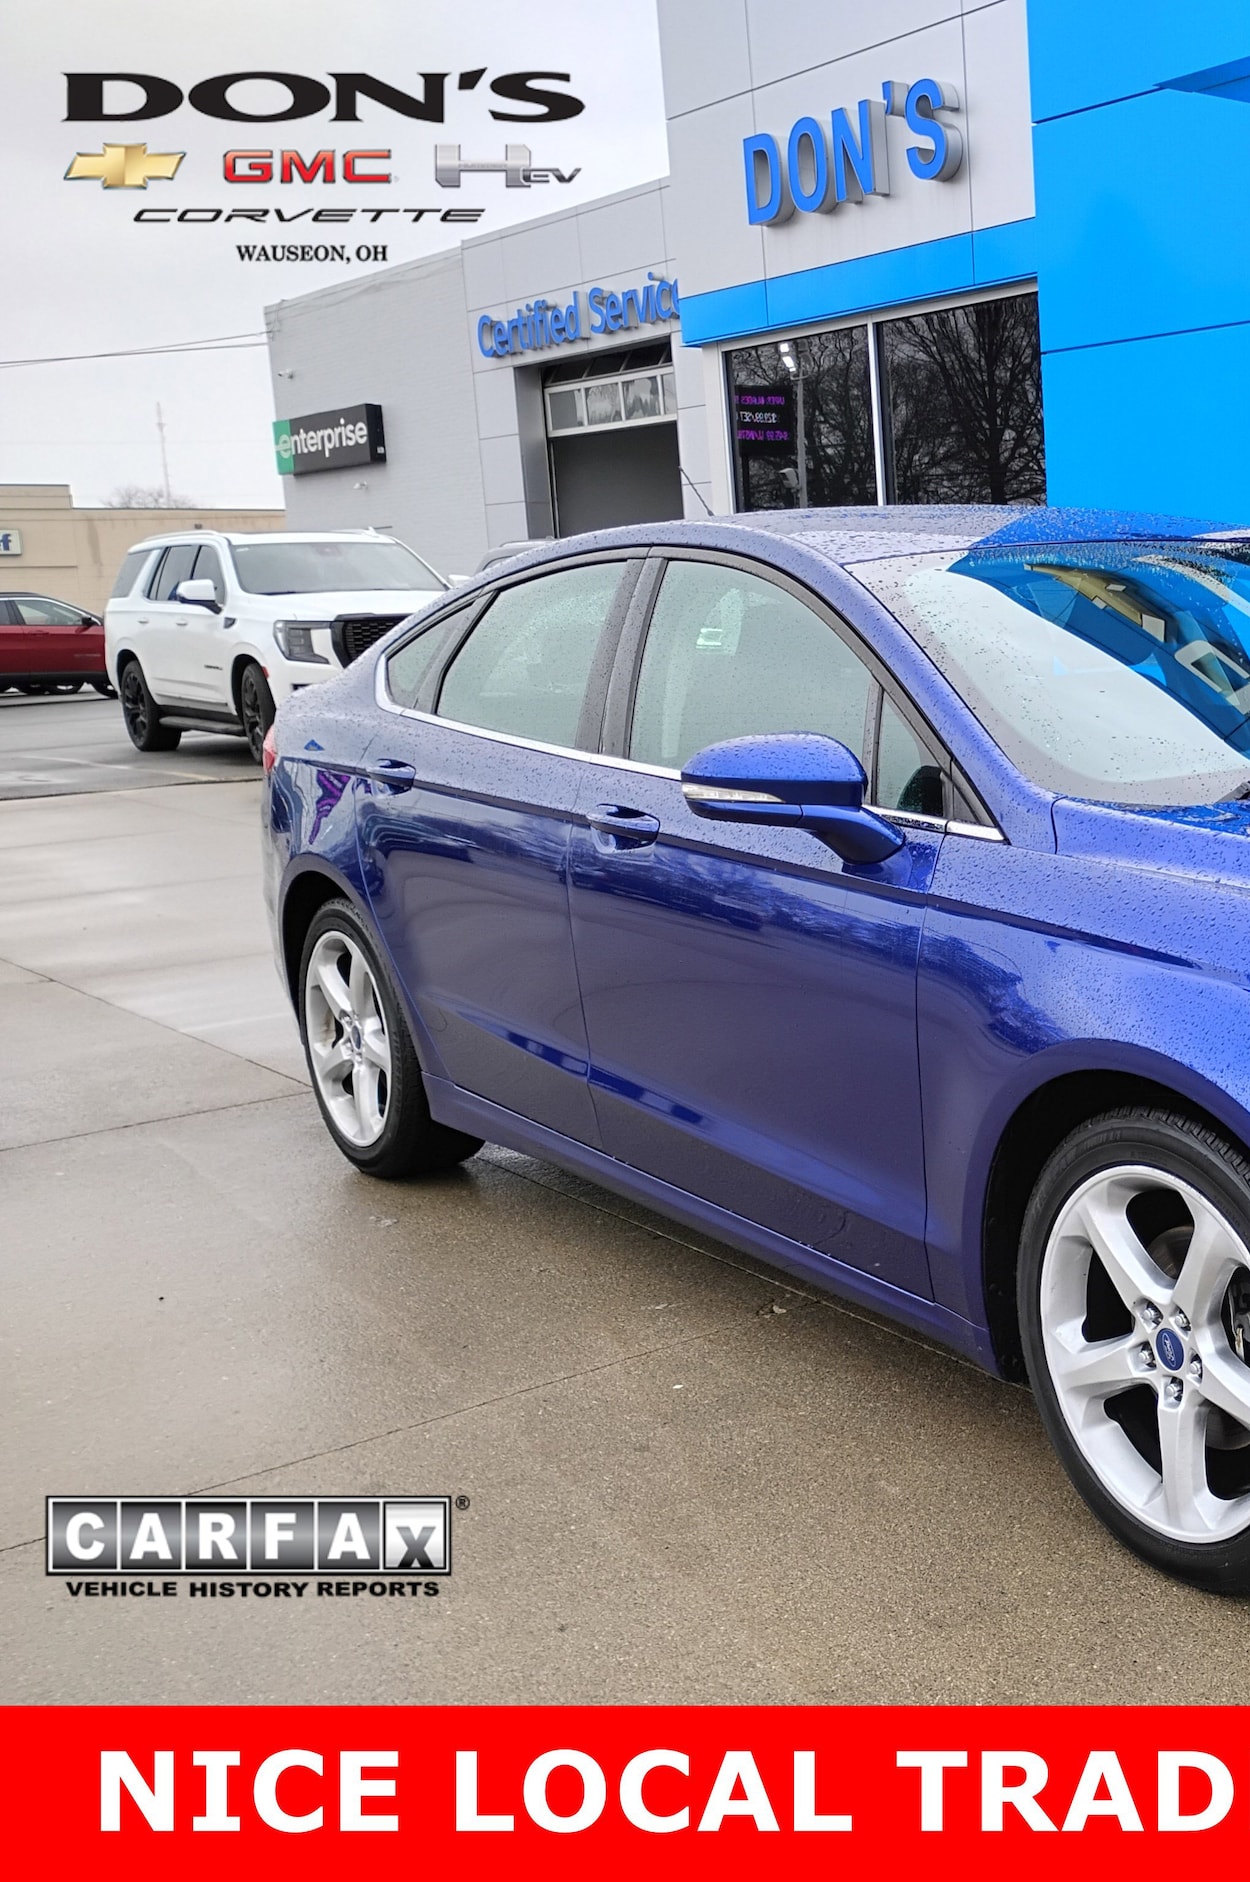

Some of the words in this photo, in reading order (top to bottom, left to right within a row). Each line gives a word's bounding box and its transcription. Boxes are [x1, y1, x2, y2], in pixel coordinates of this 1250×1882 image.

[743, 78, 962, 226] DON'S
[477, 297, 582, 359] Certified
[276, 417, 368, 459] enterprise
